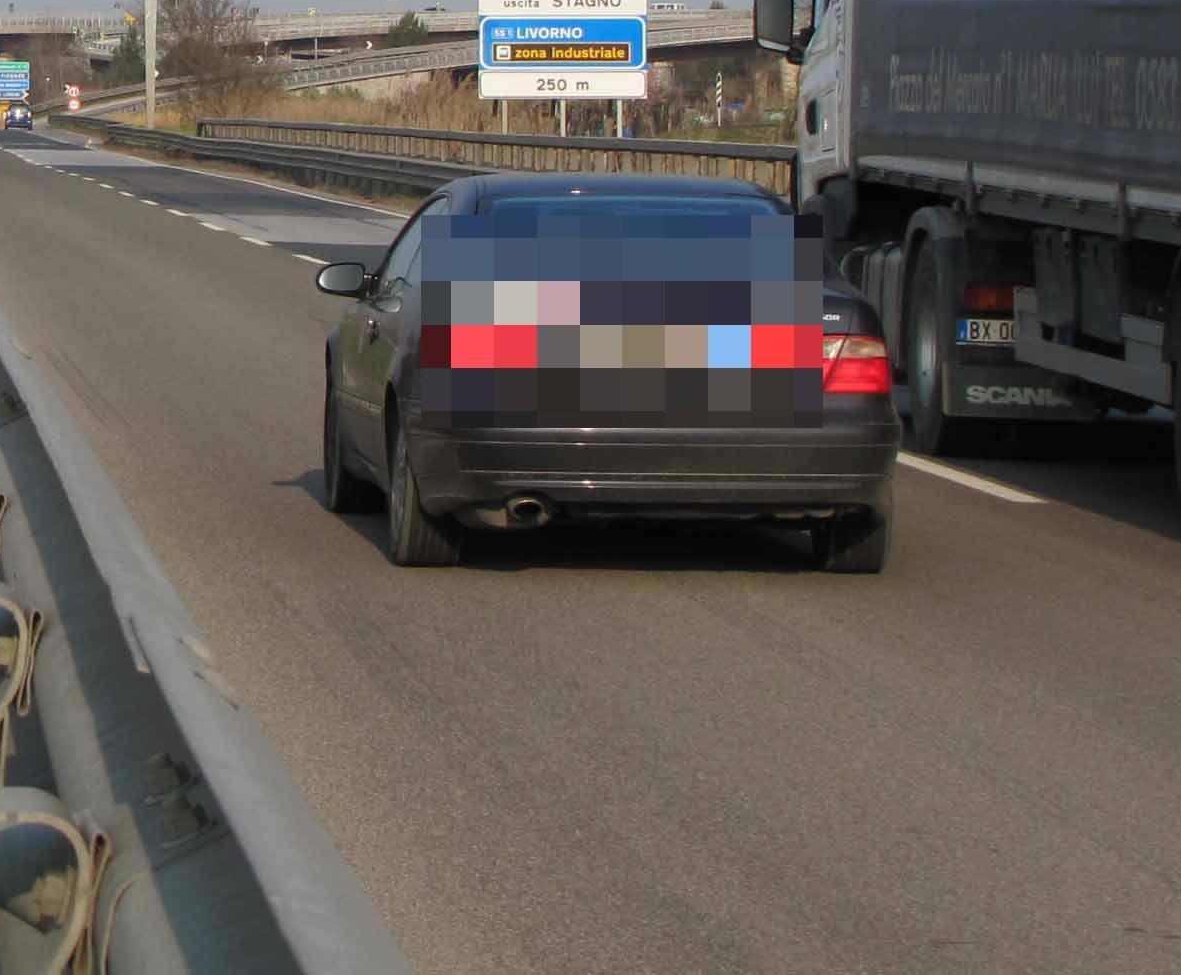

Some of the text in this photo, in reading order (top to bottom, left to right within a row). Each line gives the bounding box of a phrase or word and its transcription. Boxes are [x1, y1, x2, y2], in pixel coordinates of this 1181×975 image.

[516, 27, 583, 39] LIVORNO
[515, 46, 625, 59] zona industriale
[536, 78, 590, 91] 250 m
[970, 321, 992, 340] BX
